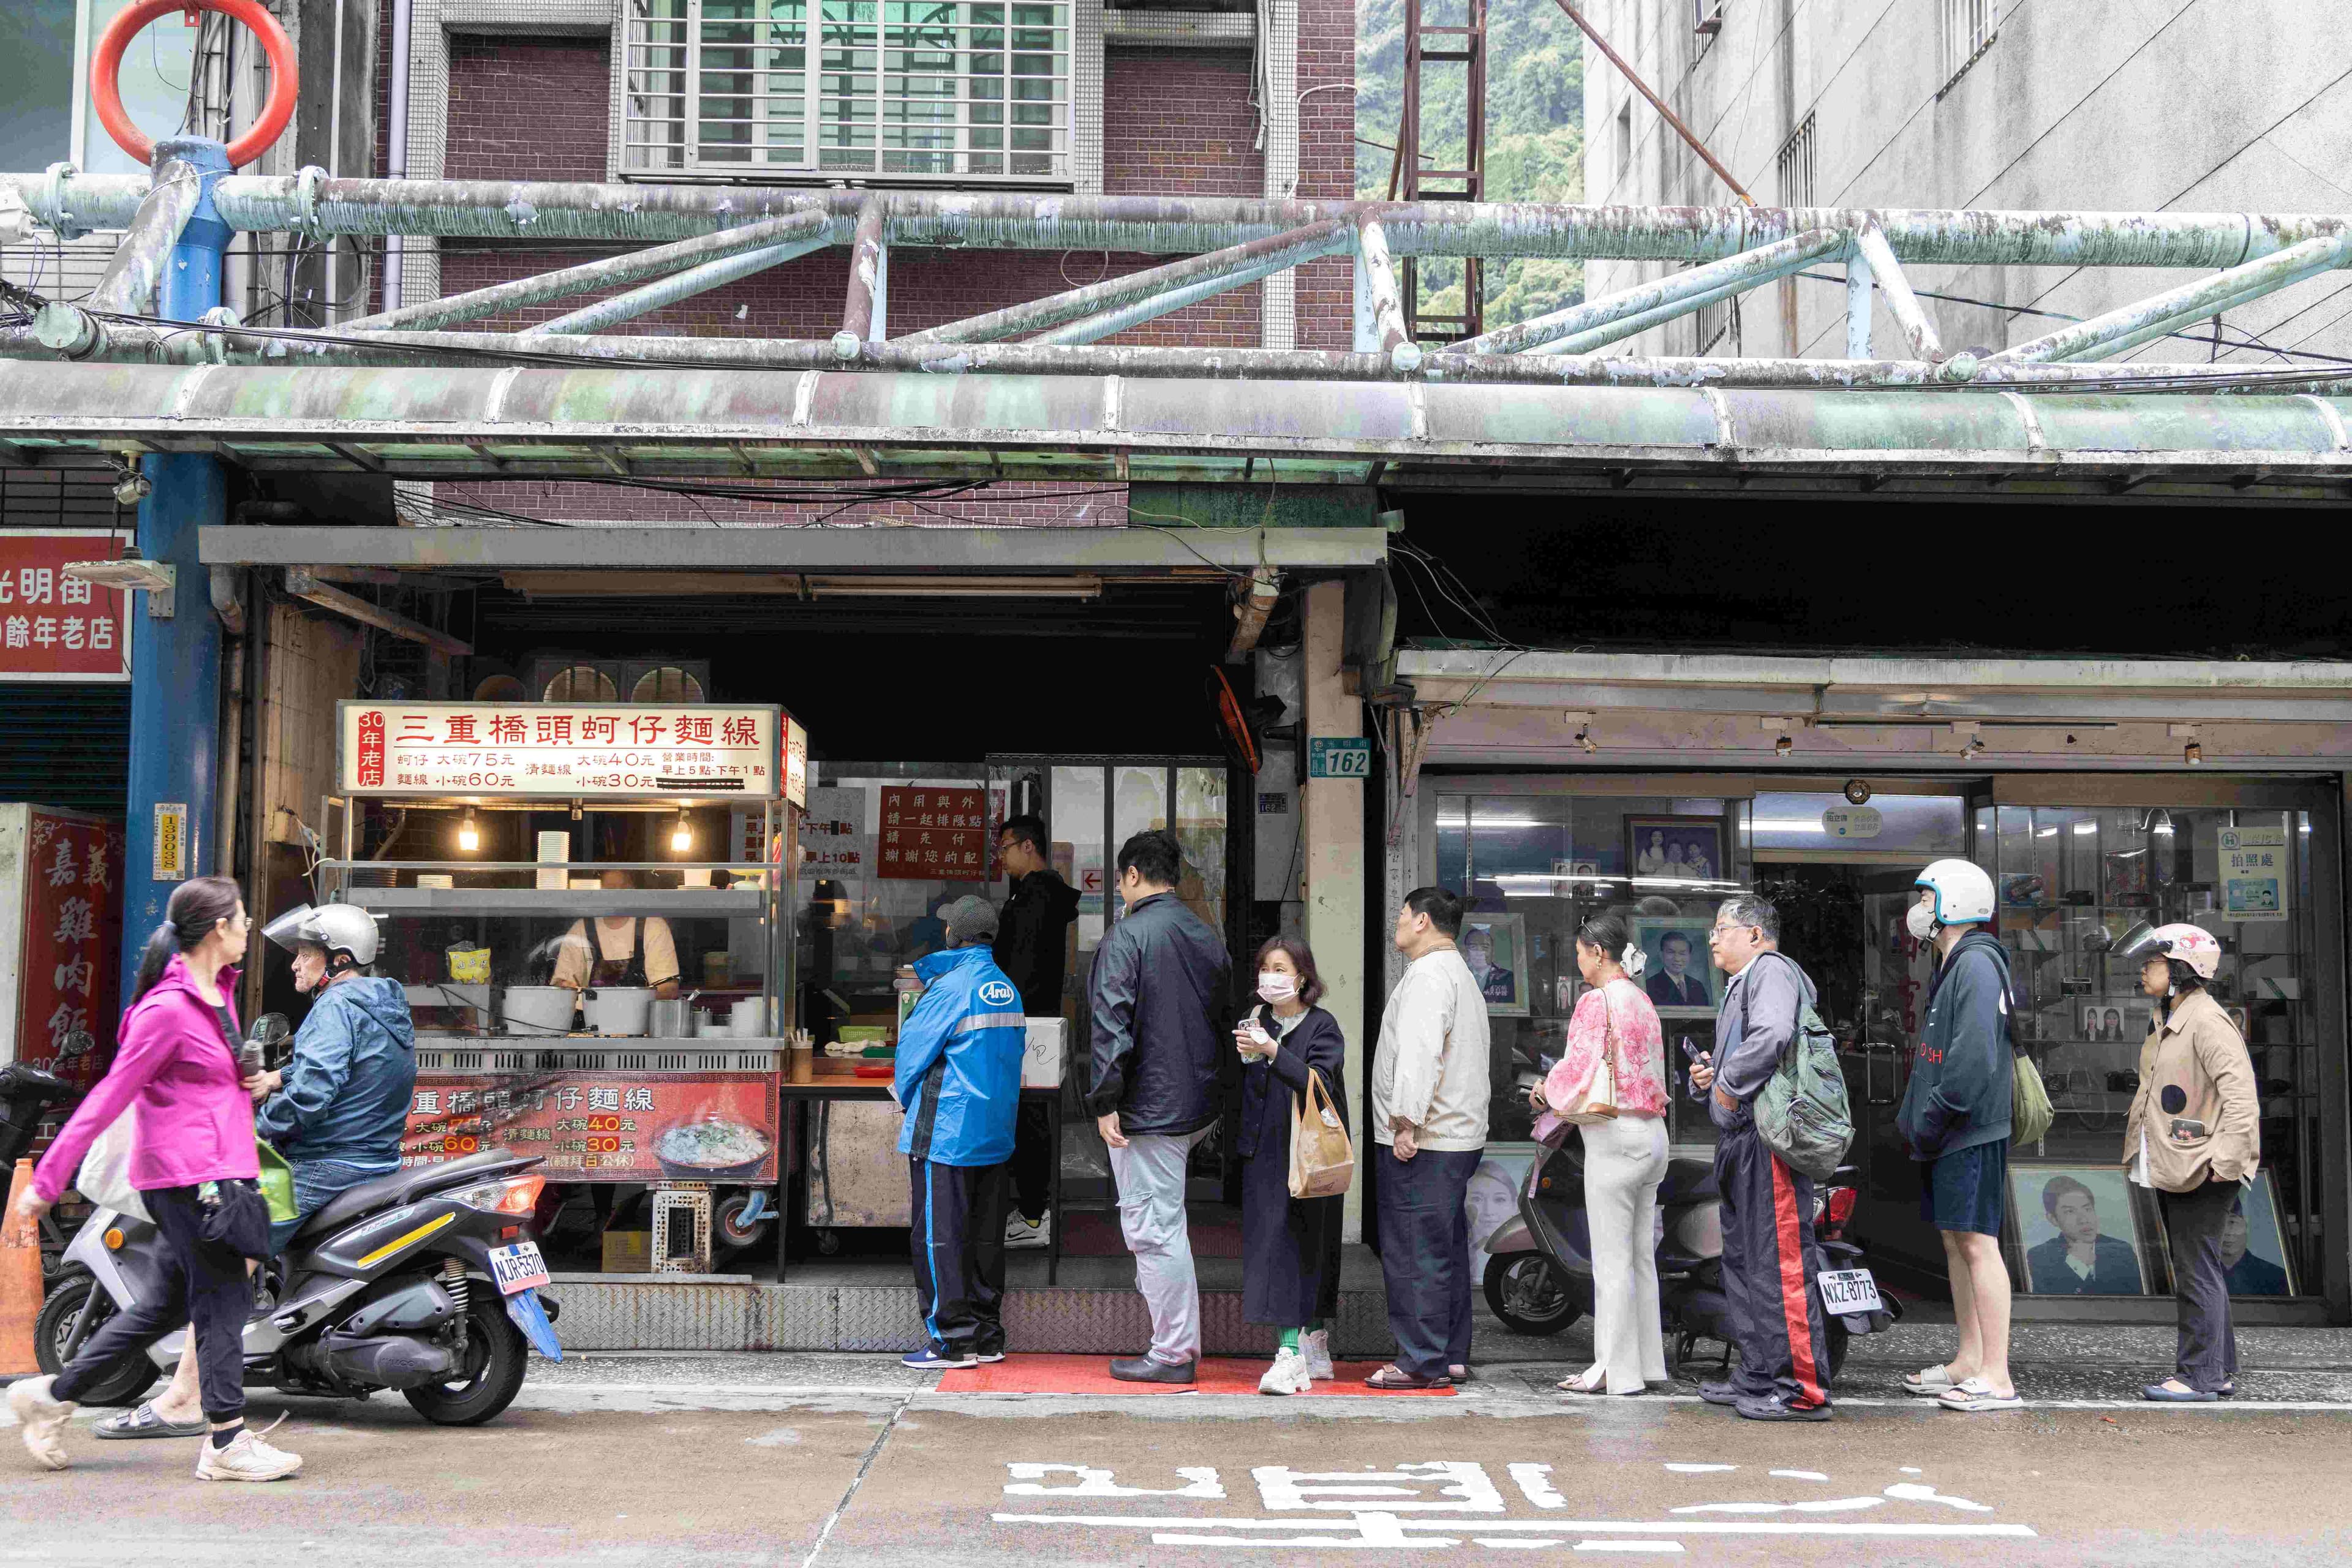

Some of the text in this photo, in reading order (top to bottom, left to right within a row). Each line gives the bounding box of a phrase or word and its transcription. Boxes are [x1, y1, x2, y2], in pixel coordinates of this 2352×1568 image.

[0, 615, 113, 649] 餘年老店
[396, 714, 760, 745] 三重橋頭蚵仔麵線
[359, 712, 385, 787] 30年老店
[397, 753, 515, 766] 蚵仔 大碗75元
[578, 753, 655, 767] 大碗40元
[662, 752, 714, 763] 營業時間:
[1330, 752, 1366, 772] 162
[525, 763, 571, 776] 清麵線
[397, 772, 515, 787] 麵線 小碗60元
[576, 773, 655, 788] 小碗30元
[45, 838, 113, 892] 嘉義
[2231, 853, 2274, 867] 拍照處
[980, 982, 1012, 1000] Arai
[556, 1117, 638, 1131] 大碗40元
[503, 1128, 552, 1142] 清麵線
[412, 1137, 492, 1153] 小碗60元
[554, 1137, 635, 1153] 小碗30元
